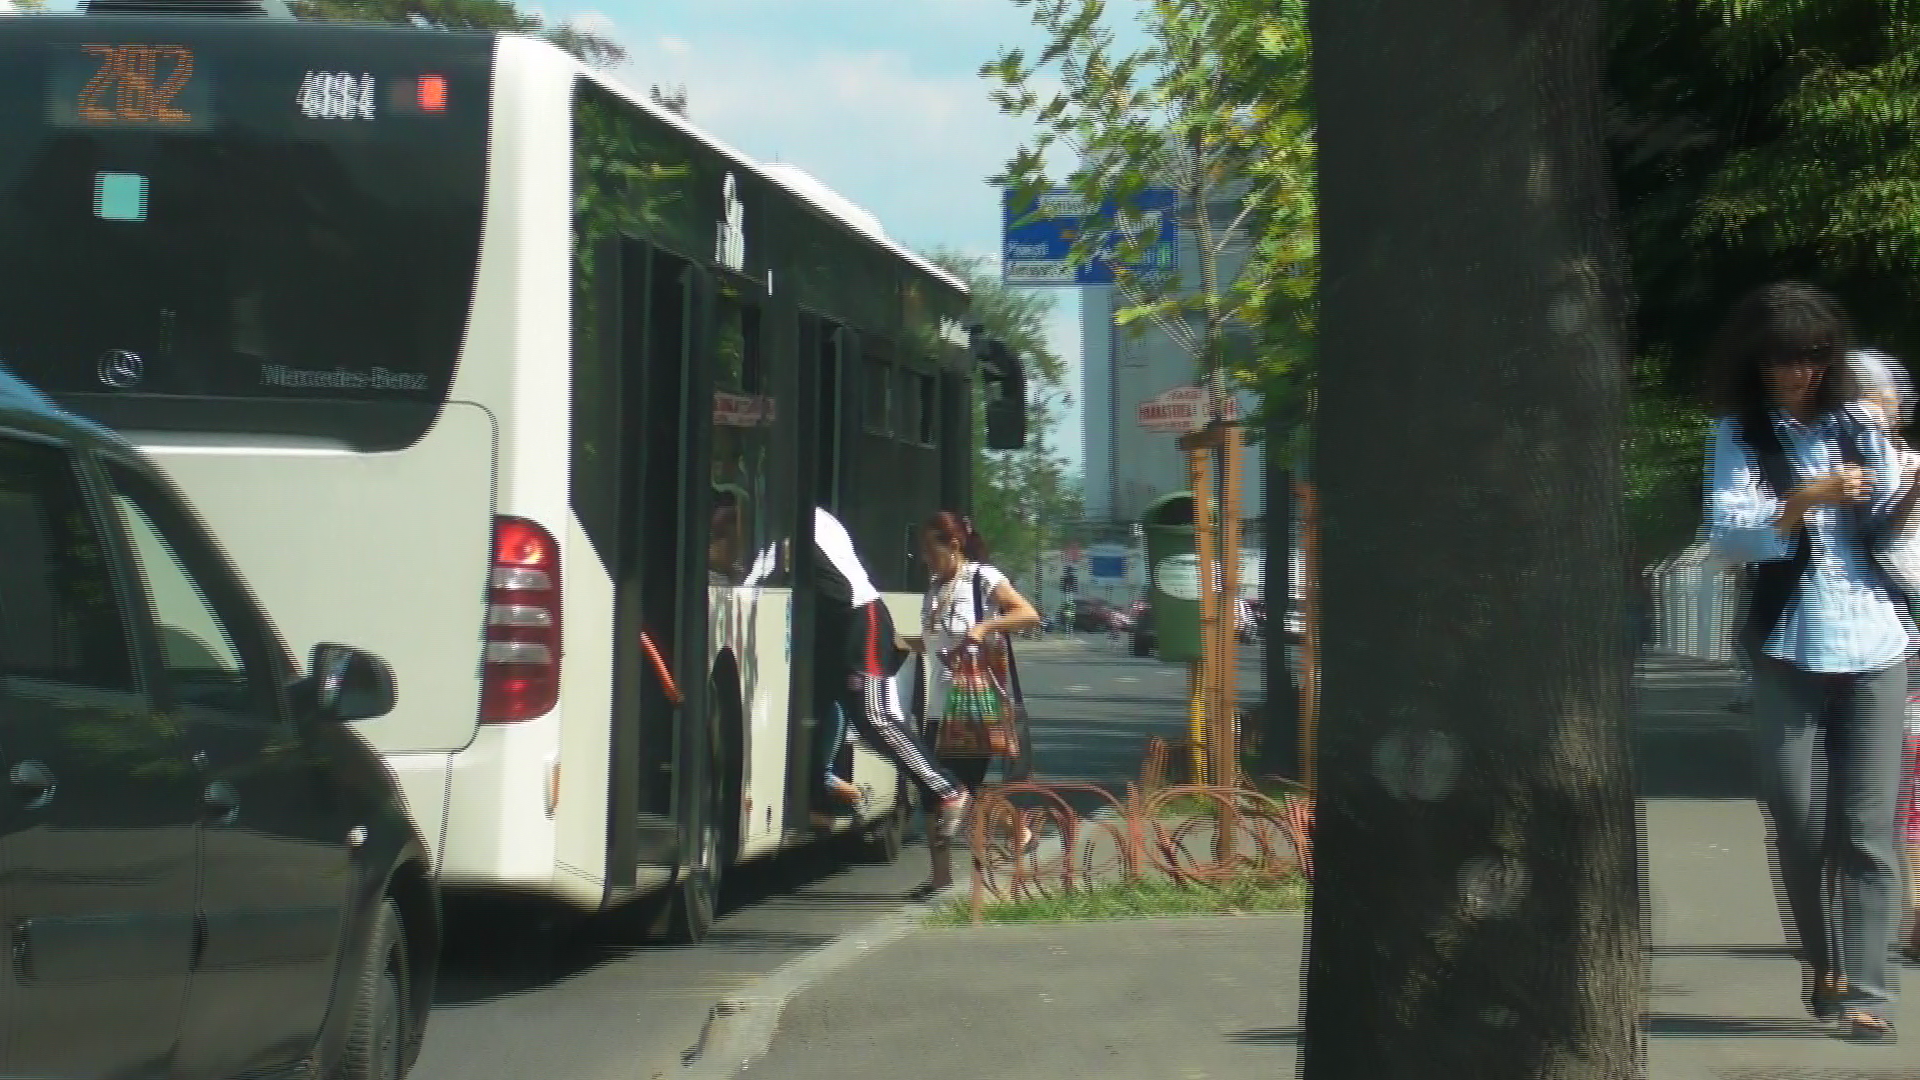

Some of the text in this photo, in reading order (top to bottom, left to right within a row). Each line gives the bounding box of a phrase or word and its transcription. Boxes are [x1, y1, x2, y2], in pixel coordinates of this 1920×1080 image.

[78, 43, 194, 122] 282
[297, 71, 376, 120] 4884
[1007, 261, 1056, 280] Aeroport
[260, 363, 428, 390] Mercedes-Benz
